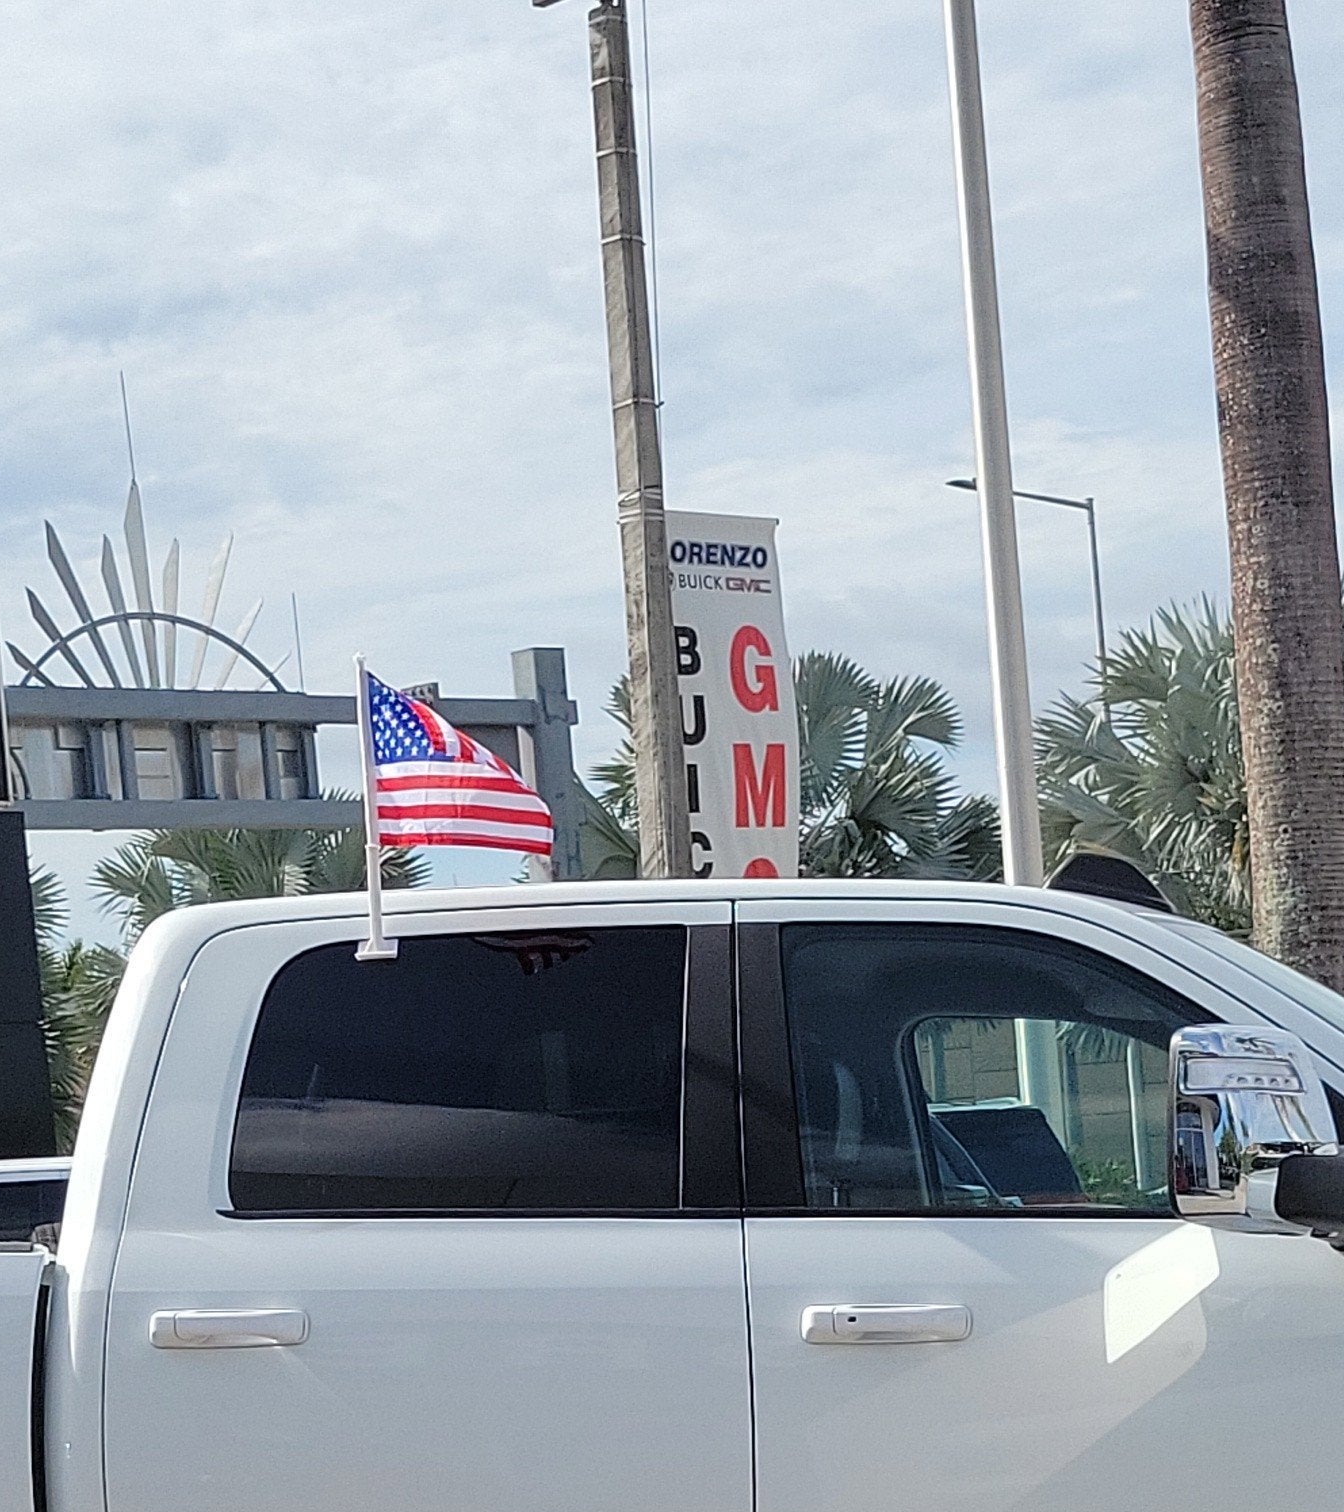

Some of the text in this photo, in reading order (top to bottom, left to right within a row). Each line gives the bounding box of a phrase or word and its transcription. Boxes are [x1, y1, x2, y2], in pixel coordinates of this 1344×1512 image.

[670, 541, 768, 569] ORENZO
[678, 574, 772, 593] BUICK GMC
[674, 626, 714, 879] BUIC
[730, 625, 786, 879] GM
